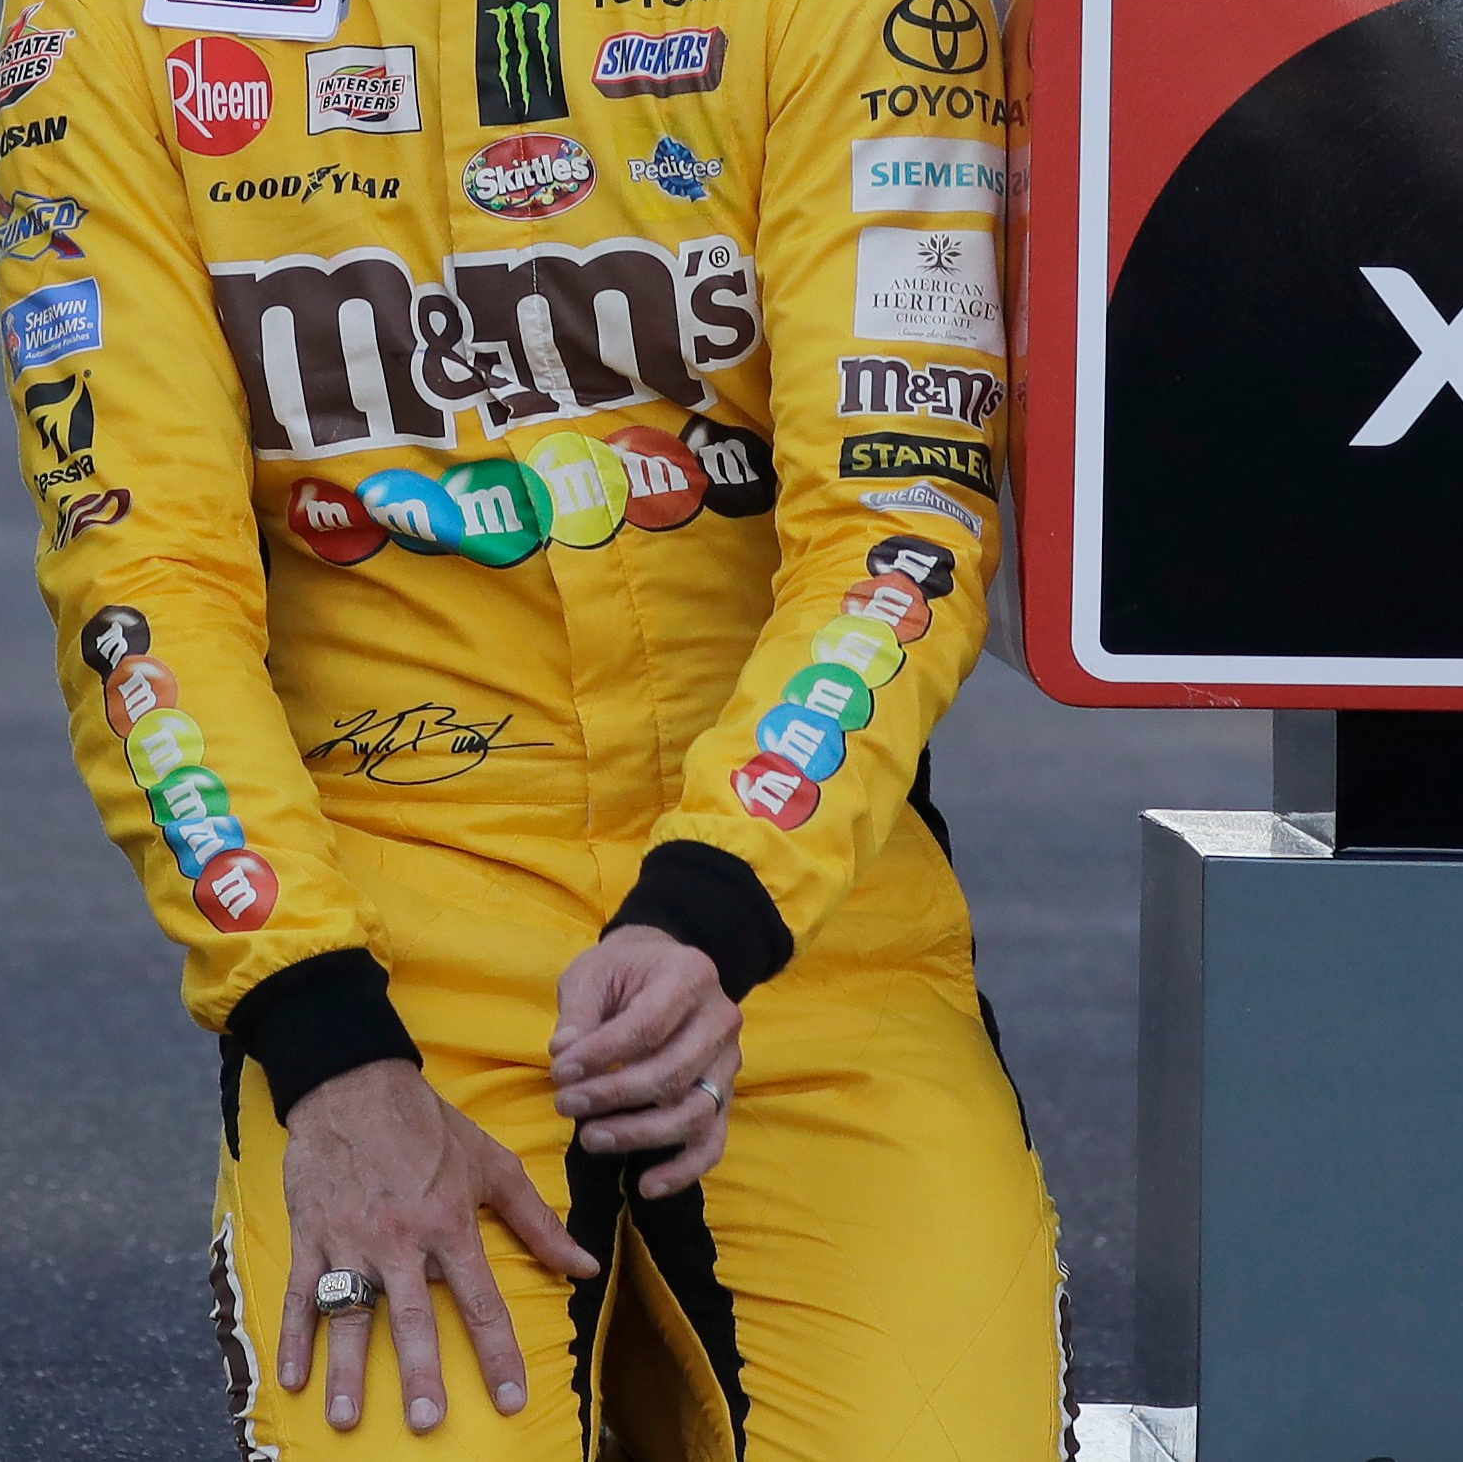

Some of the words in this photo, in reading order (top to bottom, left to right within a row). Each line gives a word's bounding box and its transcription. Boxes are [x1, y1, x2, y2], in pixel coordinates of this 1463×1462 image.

[601, 35, 708, 75] SNICKERS
[166, 39, 268, 138] Rheem
[861, 85, 1007, 127] TOYOTA
[475, 154, 590, 201] Skittles
[870, 161, 1005, 197] SIEMENS
[890, 277, 984, 297] AMERICAN
[25, 299, 87, 332] SHERWIN
[872, 292, 998, 322] HERITAGE
[895, 312, 974, 330] CHOCOLATE
[25, 317, 88, 351] WILLIAMS
[875, 487, 972, 528] FREIGHTLINER
